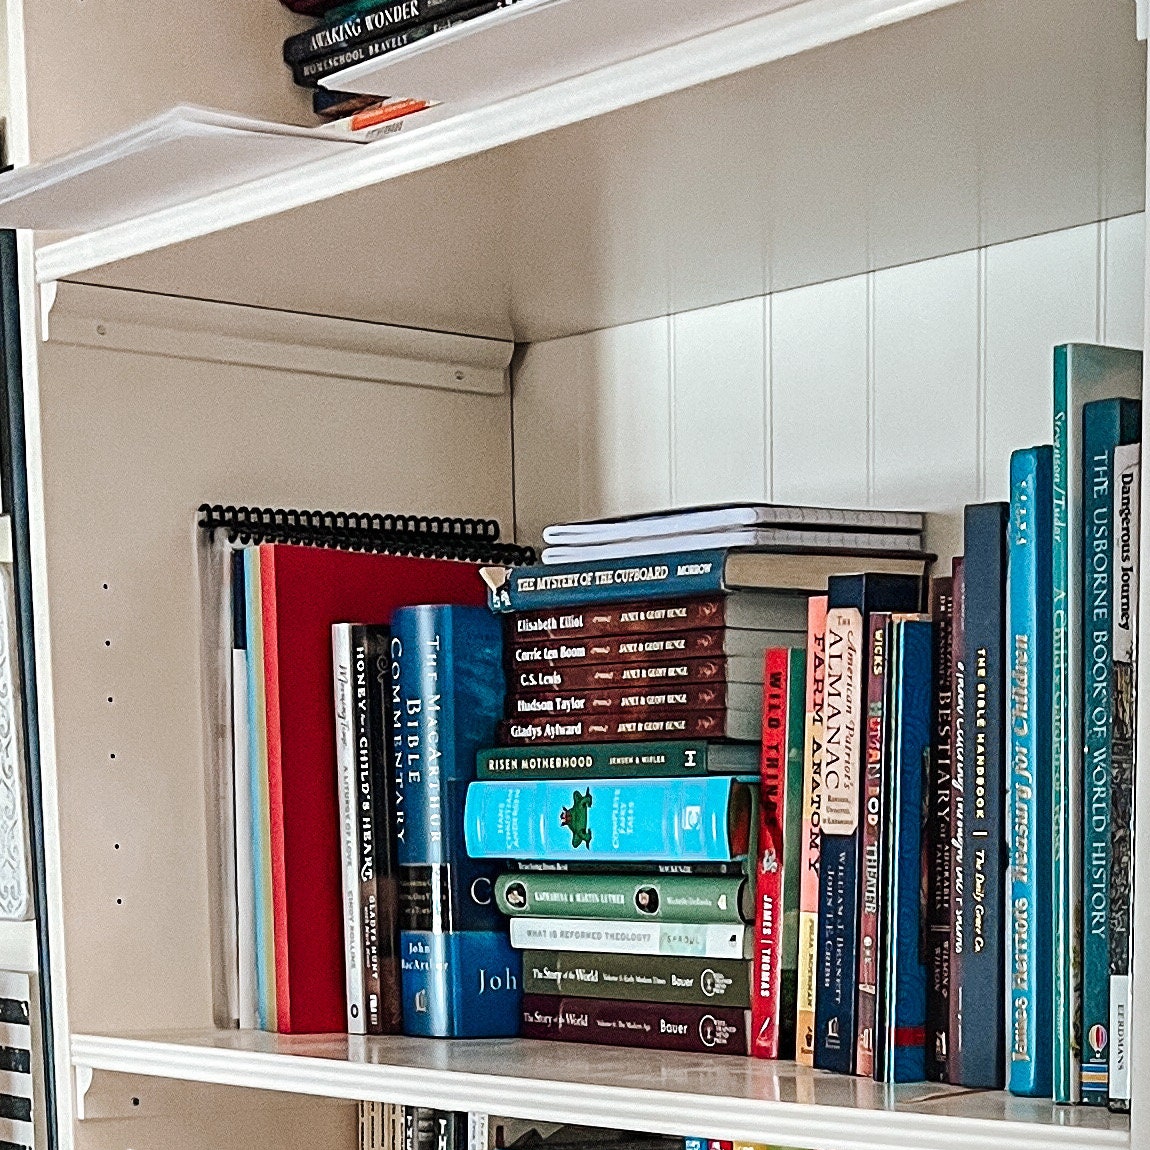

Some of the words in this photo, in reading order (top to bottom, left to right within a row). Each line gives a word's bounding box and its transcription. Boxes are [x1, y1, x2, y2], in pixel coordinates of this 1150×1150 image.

[310, 16, 362, 51] AWAKING
[364, 0, 420, 31] WONDER
[303, 48, 365, 77] HOMESCHOOL
[368, 34, 409, 56] BRAVELY
[1093, 450, 1108, 498] THE
[1119, 472, 1134, 563] Dangerous
[517, 578, 534, 592] THE
[536, 573, 580, 591] MYSTERY
[579, 573, 593, 586] OF
[595, 572, 613, 585] THE
[614, 565, 669, 583] CUPBOARD
[1093, 507, 1108, 621] USBORNE
[356, 646, 366, 708] HONEY
[813, 633, 825, 726] FARM
[844, 630, 858, 715] American
[873, 629, 884, 675] WICKS
[977, 648, 987, 677] THE
[1093, 630, 1108, 698] BOOK
[517, 698, 553, 713] Hudson
[555, 697, 586, 713] Taylor
[768, 671, 783, 730] WILD
[825, 629, 843, 791] ALMANAC
[976, 683, 987, 728] BIBLE
[1011, 634, 1029, 737] Children
[391, 637, 405, 844] COMMENTARY
[406, 698, 422, 784] BIBLE
[510, 724, 542, 740] Gladys
[543, 722, 582, 739] Aylward
[867, 700, 883, 780] HUMAN
[1092, 706, 1108, 738] OF
[360, 736, 371, 811] CHILD'S
[488, 757, 518, 771] RISEN
[521, 755, 593, 770] MOTHERHOOD
[843, 719, 857, 791] Patriot's
[937, 691, 951, 822] BESTIARY
[975, 733, 986, 819] HANDBOOK
[1014, 741, 1033, 783] for
[809, 738, 824, 879] ANATOMY
[1092, 746, 1107, 832] WORLD
[361, 816, 374, 883] HEART
[976, 849, 985, 870] The
[1011, 782, 1032, 884] Treasury
[864, 841, 878, 915] THEATER
[1091, 841, 1106, 939] HISTORY
[368, 895, 378, 942] GLADYS
[762, 894, 773, 936] JAMES
[370, 945, 379, 980] HUNT
[409, 942, 431, 954] John
[575, 968, 599, 982] World
[760, 948, 772, 998] THOMAS
[671, 974, 694, 988] Bauer
[565, 1013, 588, 1028] World
[660, 1018, 688, 1034] Bauer
[1012, 995, 1031, 1062] James
